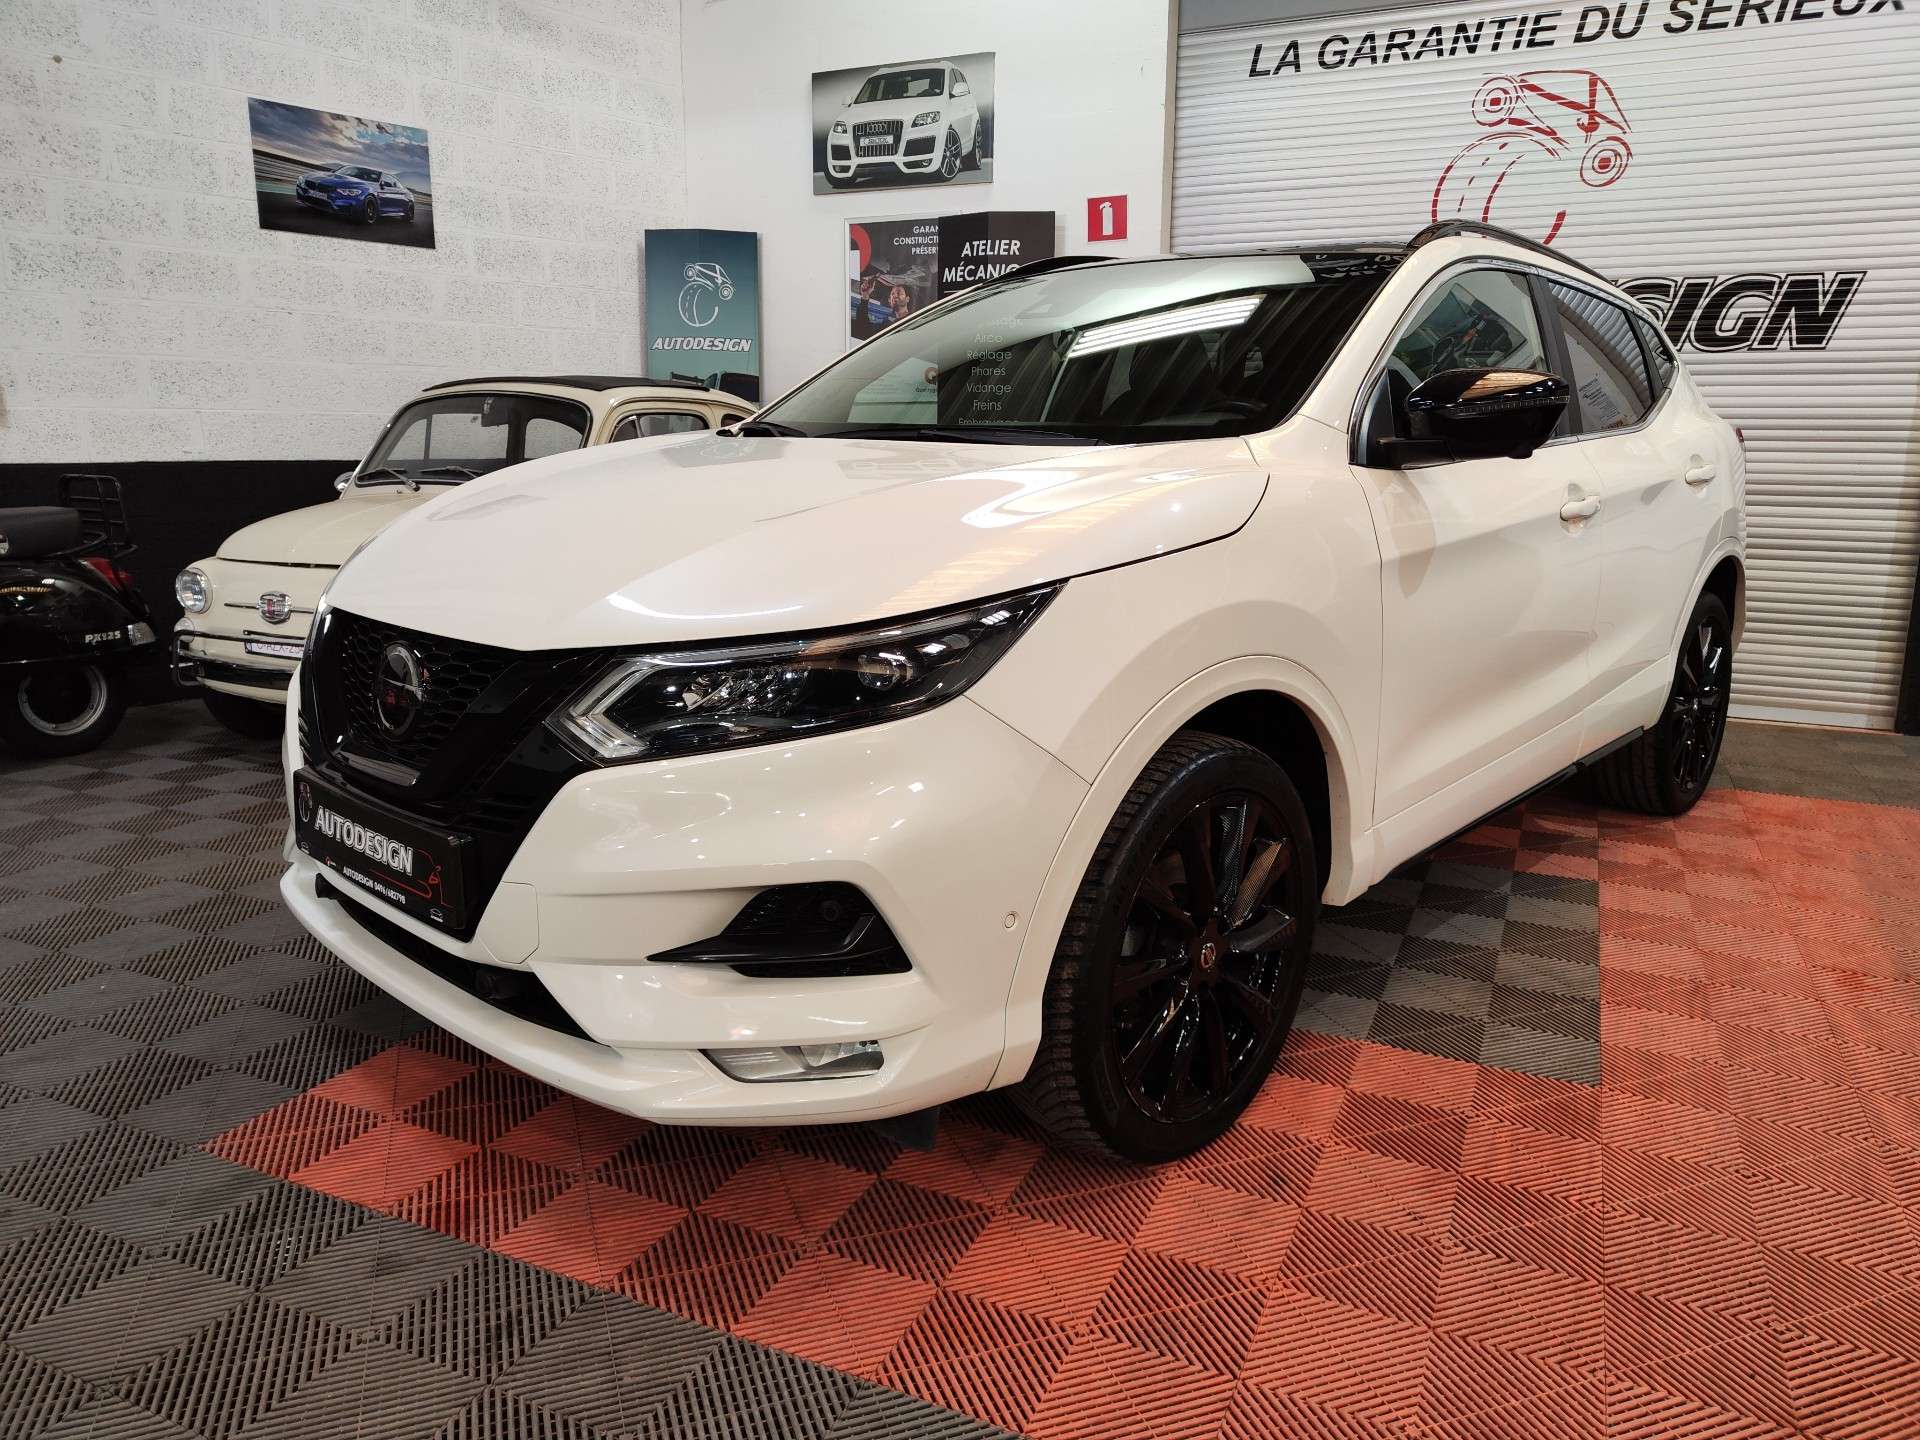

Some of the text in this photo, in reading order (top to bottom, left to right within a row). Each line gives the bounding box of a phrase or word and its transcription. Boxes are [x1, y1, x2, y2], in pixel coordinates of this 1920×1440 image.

[1248, 40, 1302, 78] LA
[1317, 10, 1563, 70] GARANTIE
[1573, 2, 1647, 44] DU
[911, 245, 939, 256] PRÉSER
[961, 239, 1021, 258] ATELIER
[652, 336, 752, 352] AUTODESIGN
[971, 366, 1006, 377] Phares
[966, 382, 1012, 395] Vidange
[973, 399, 1002, 411] Freins
[84, 630, 121, 645] PX125
[314, 805, 414, 876] AUTODESIGN
[343, 866, 374, 888] AUTODESIGN
